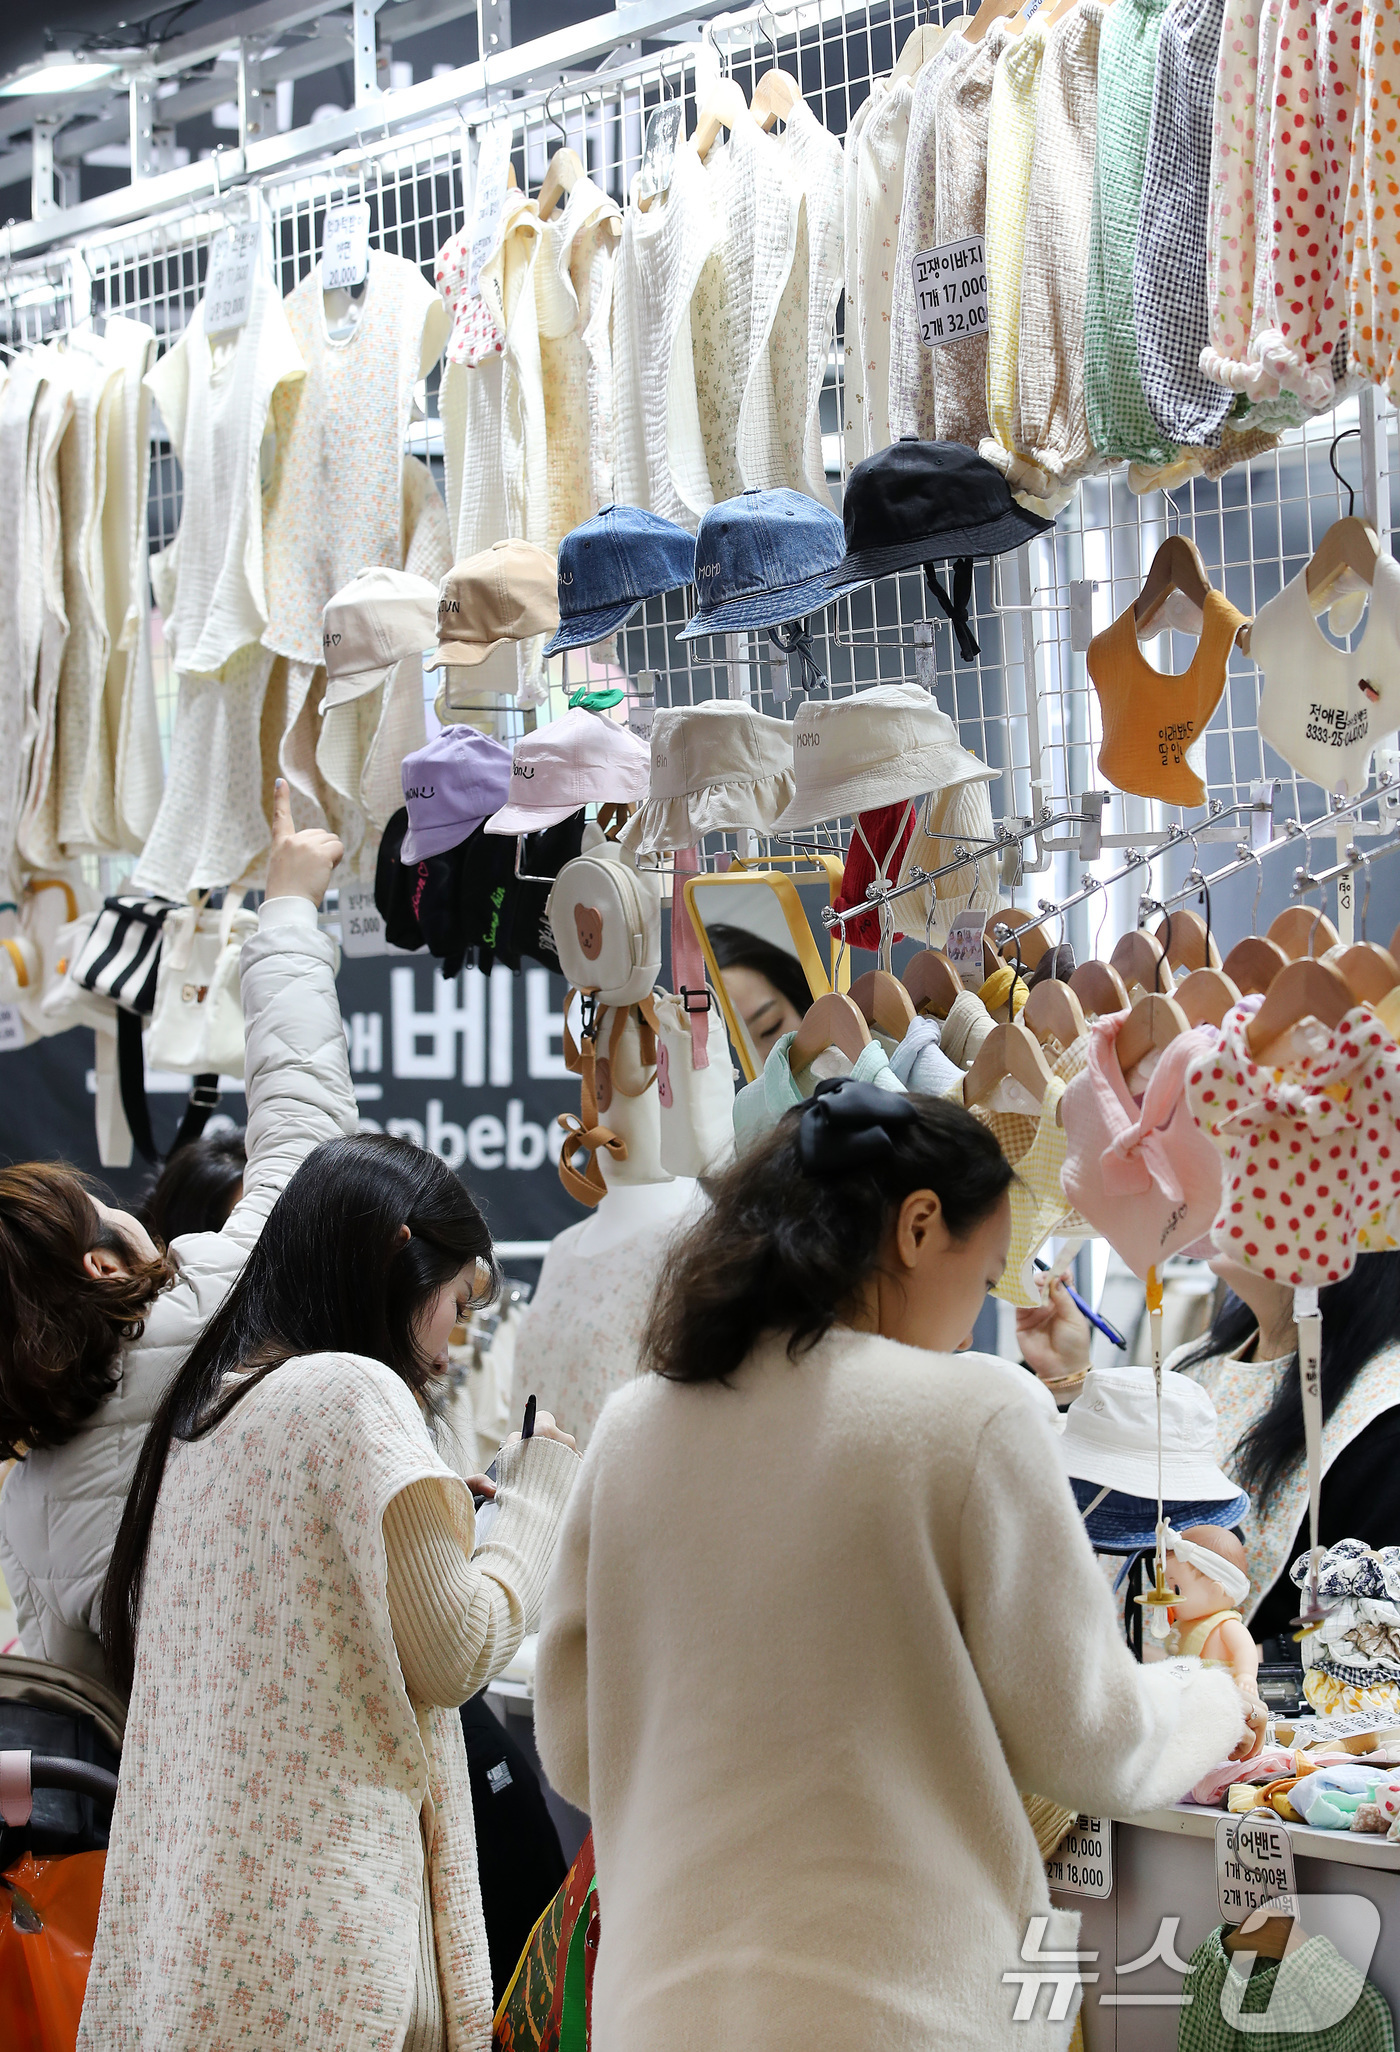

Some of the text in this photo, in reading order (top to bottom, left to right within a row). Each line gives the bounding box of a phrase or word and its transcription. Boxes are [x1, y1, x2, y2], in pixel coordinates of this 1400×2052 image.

[329, 266, 357, 287] 20,000
[916, 245, 983, 282] 고쟁이바지
[919, 275, 987, 310] 1개 17,000
[922, 306, 987, 340] 2개 32,00
[349, 917, 381, 936] 25,000
[1066, 1834, 1102, 1857] 10,000
[1226, 1828, 1282, 1860] 헤어밴드
[1047, 1862, 1103, 1887] 2개 18,000
[1225, 1861, 1288, 1890] 1개 8,000원
[1223, 1889, 1241, 1906] 2개
